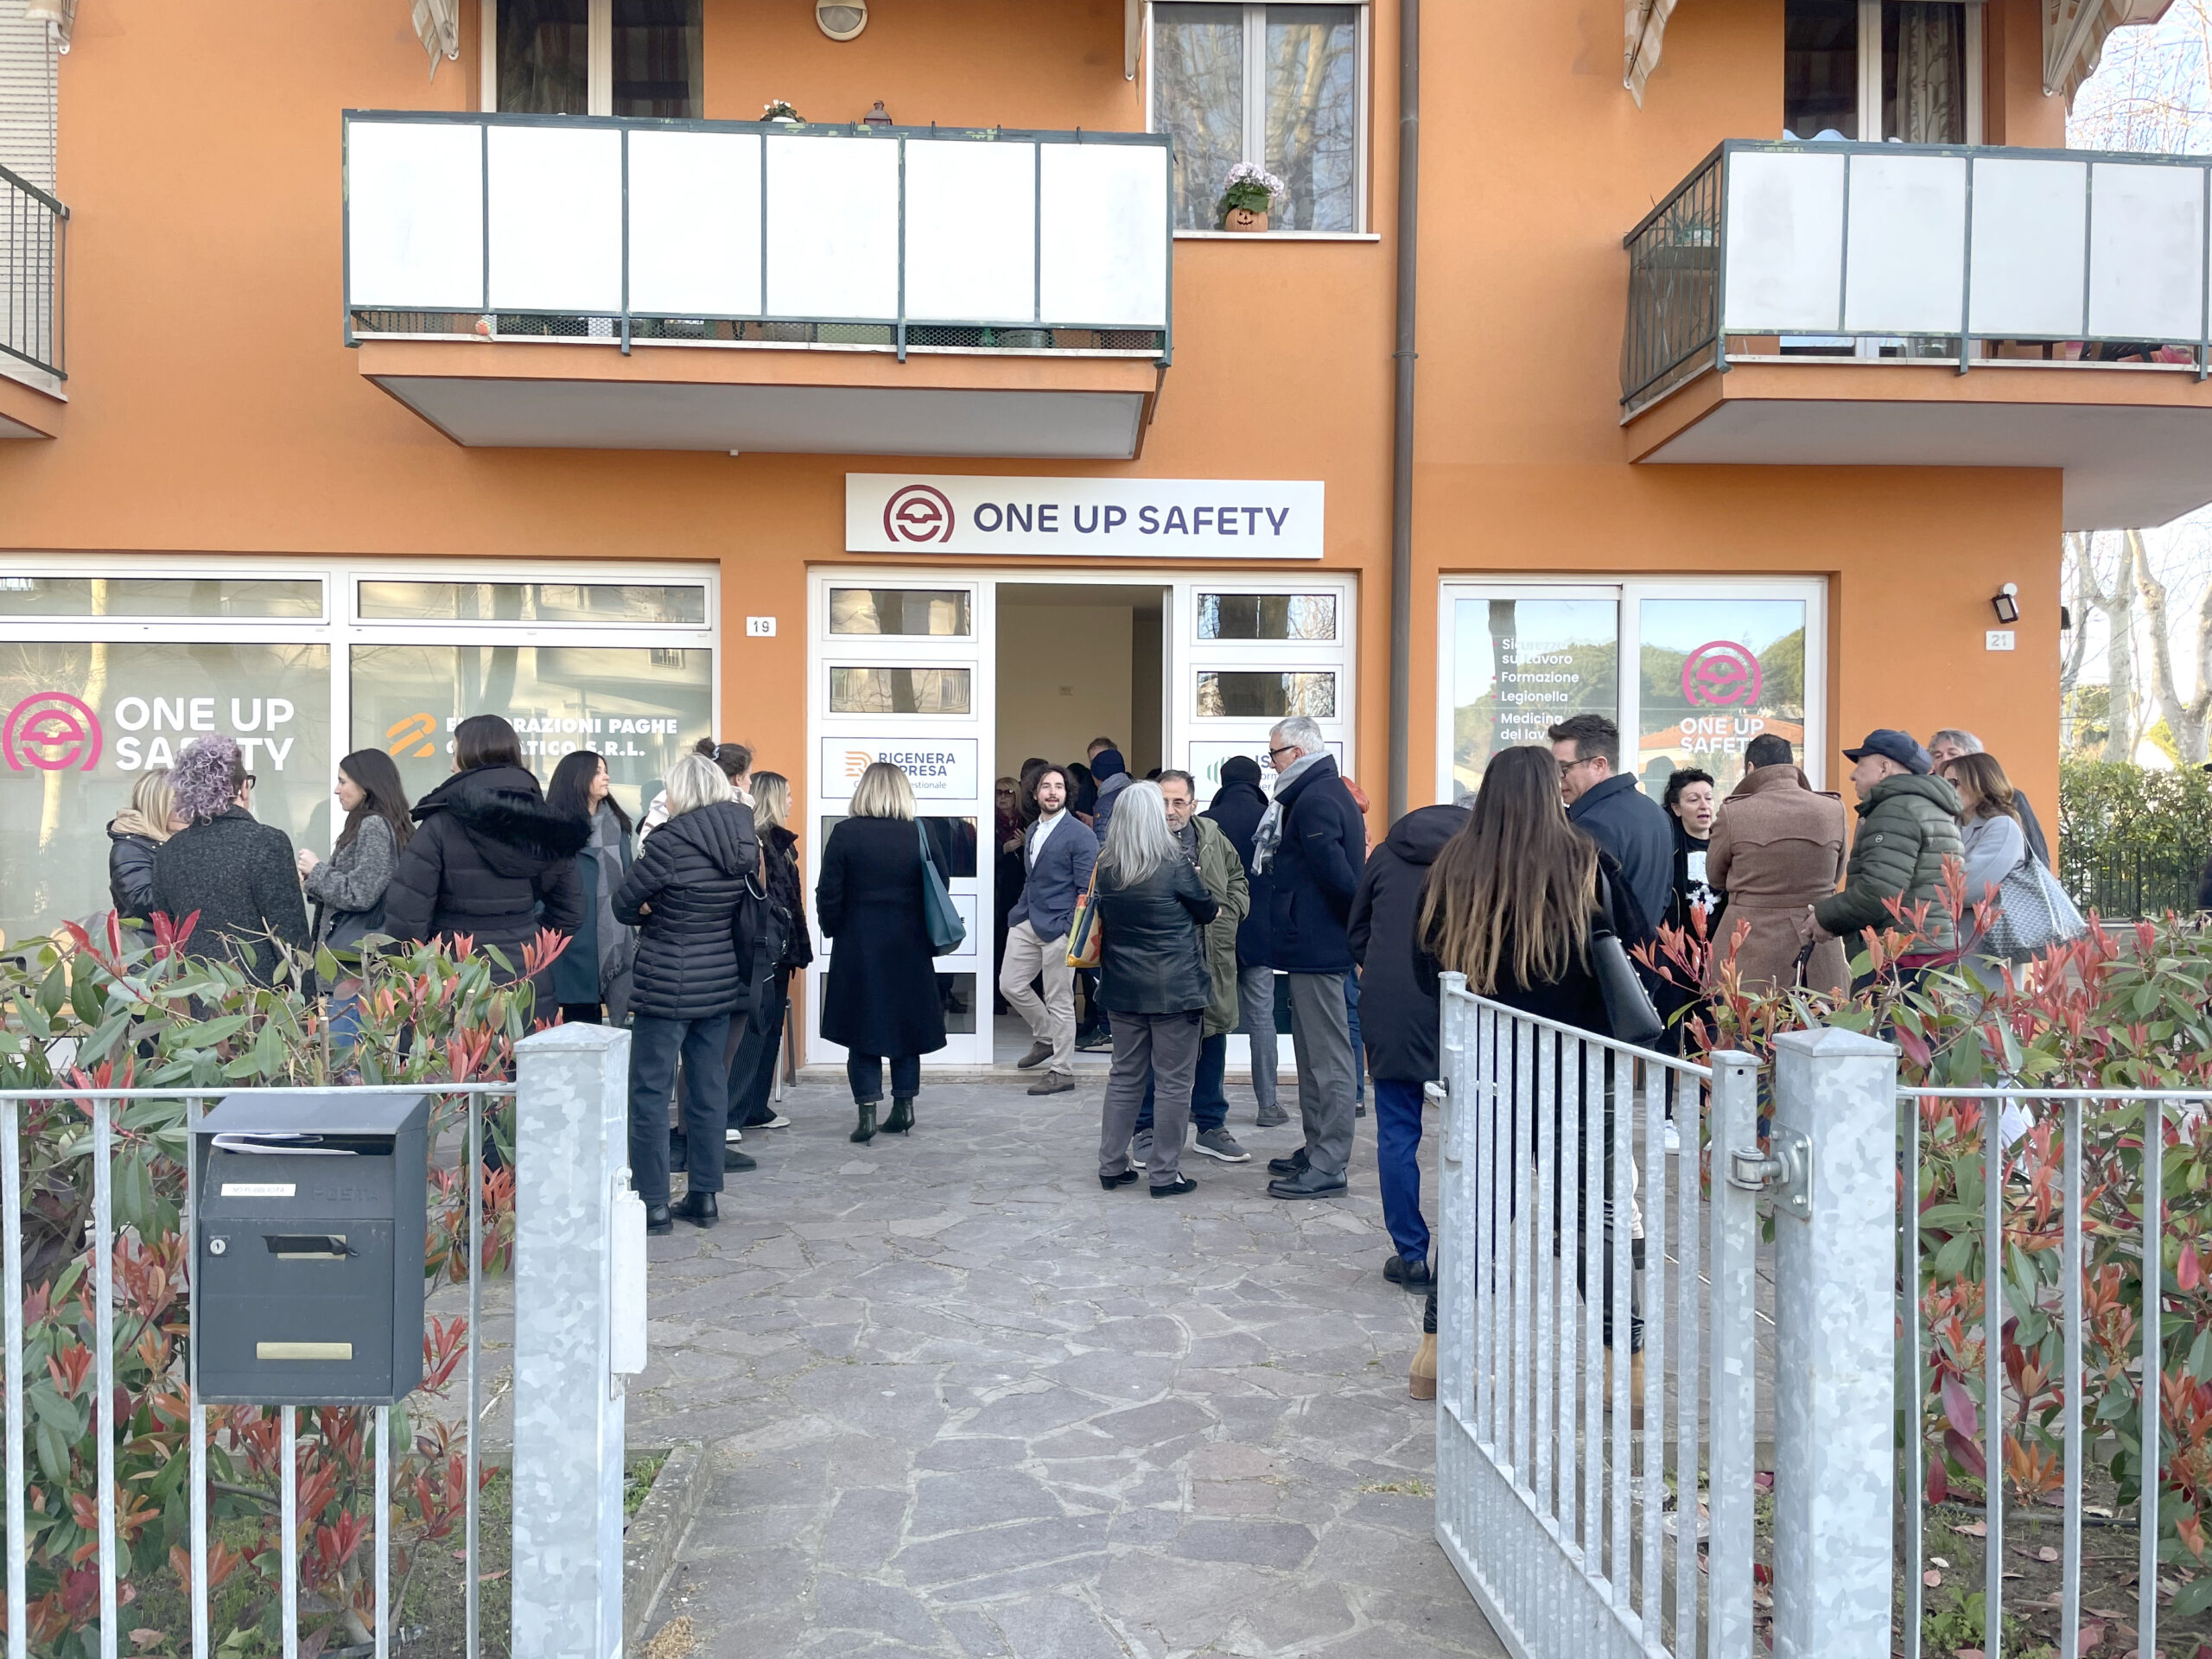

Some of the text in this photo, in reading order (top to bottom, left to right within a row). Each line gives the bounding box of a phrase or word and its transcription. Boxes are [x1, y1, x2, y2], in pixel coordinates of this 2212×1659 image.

[973, 502, 1290, 536] ONE UP SAFETY
[753, 620, 770, 632] 19
[1991, 633, 2006, 646] 21
[1501, 671, 1580, 683] Formazione
[1501, 690, 1568, 705] Legionella
[115, 696, 295, 732] ONE UP
[1501, 713, 1564, 724] Medicina
[608, 718, 677, 734] PAGHE
[1680, 717, 1765, 735] ONE UP
[1500, 728, 1522, 741] del
[1680, 736, 1755, 754] SAFET
[115, 736, 295, 771] SATY
[878, 753, 956, 764] RIGENERA
[899, 765, 948, 776] PRESA
[910, 780, 947, 790] estionale
